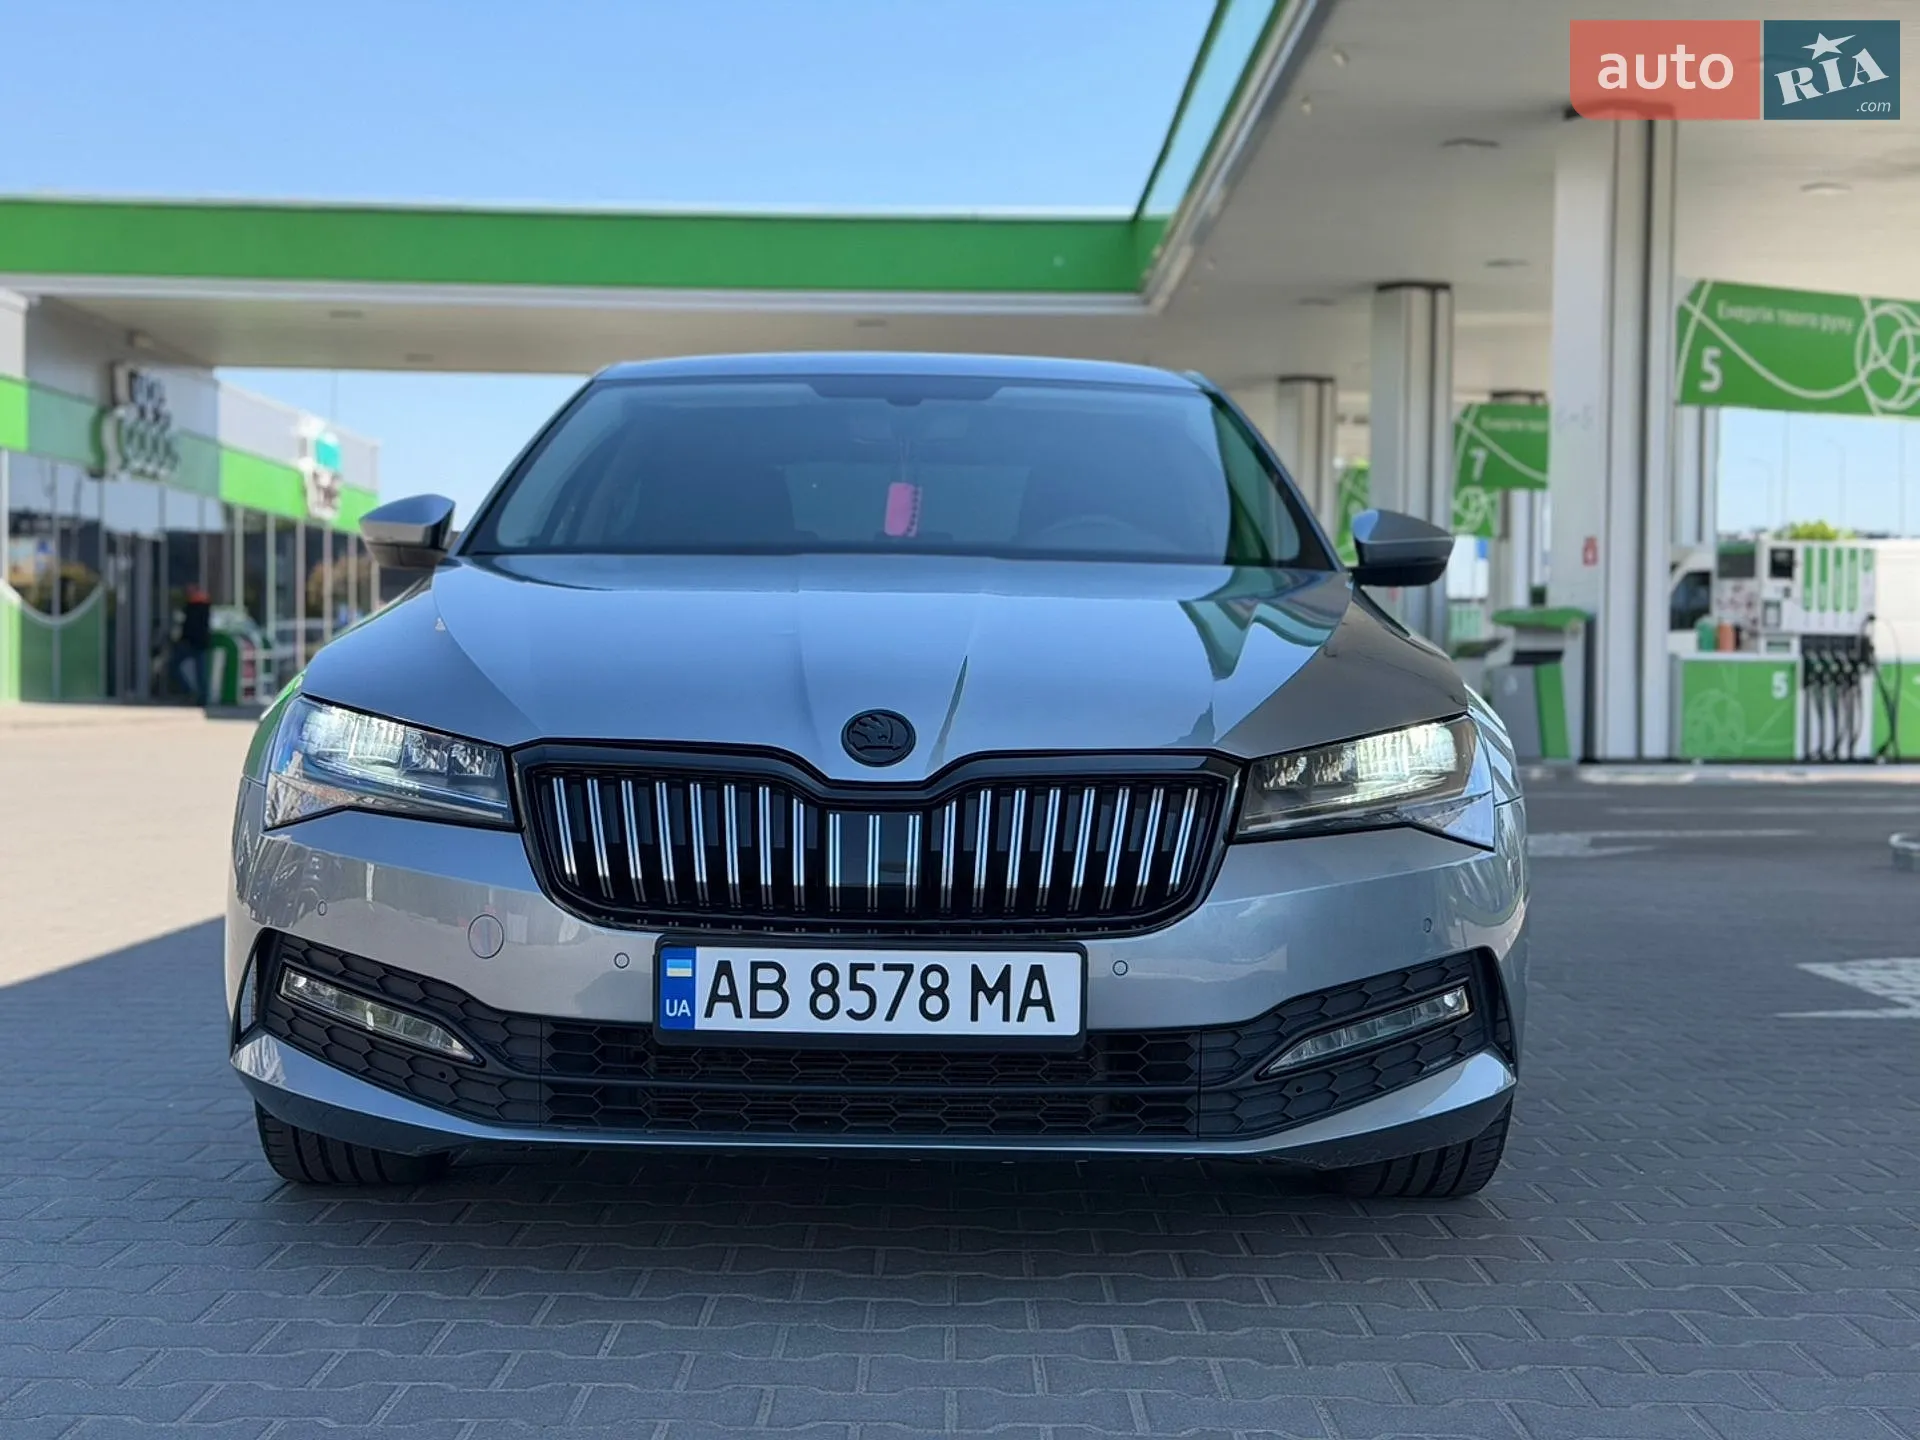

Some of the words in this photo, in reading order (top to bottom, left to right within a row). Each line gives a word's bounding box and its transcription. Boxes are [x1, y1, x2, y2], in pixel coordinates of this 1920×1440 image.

[1699, 345, 1723, 393] 5
[1771, 670, 1789, 699] 5
[664, 998, 692, 1018] UA
[703, 959, 790, 1020] AB
[808, 961, 951, 1022] 8578
[970, 963, 1056, 1023] MA
